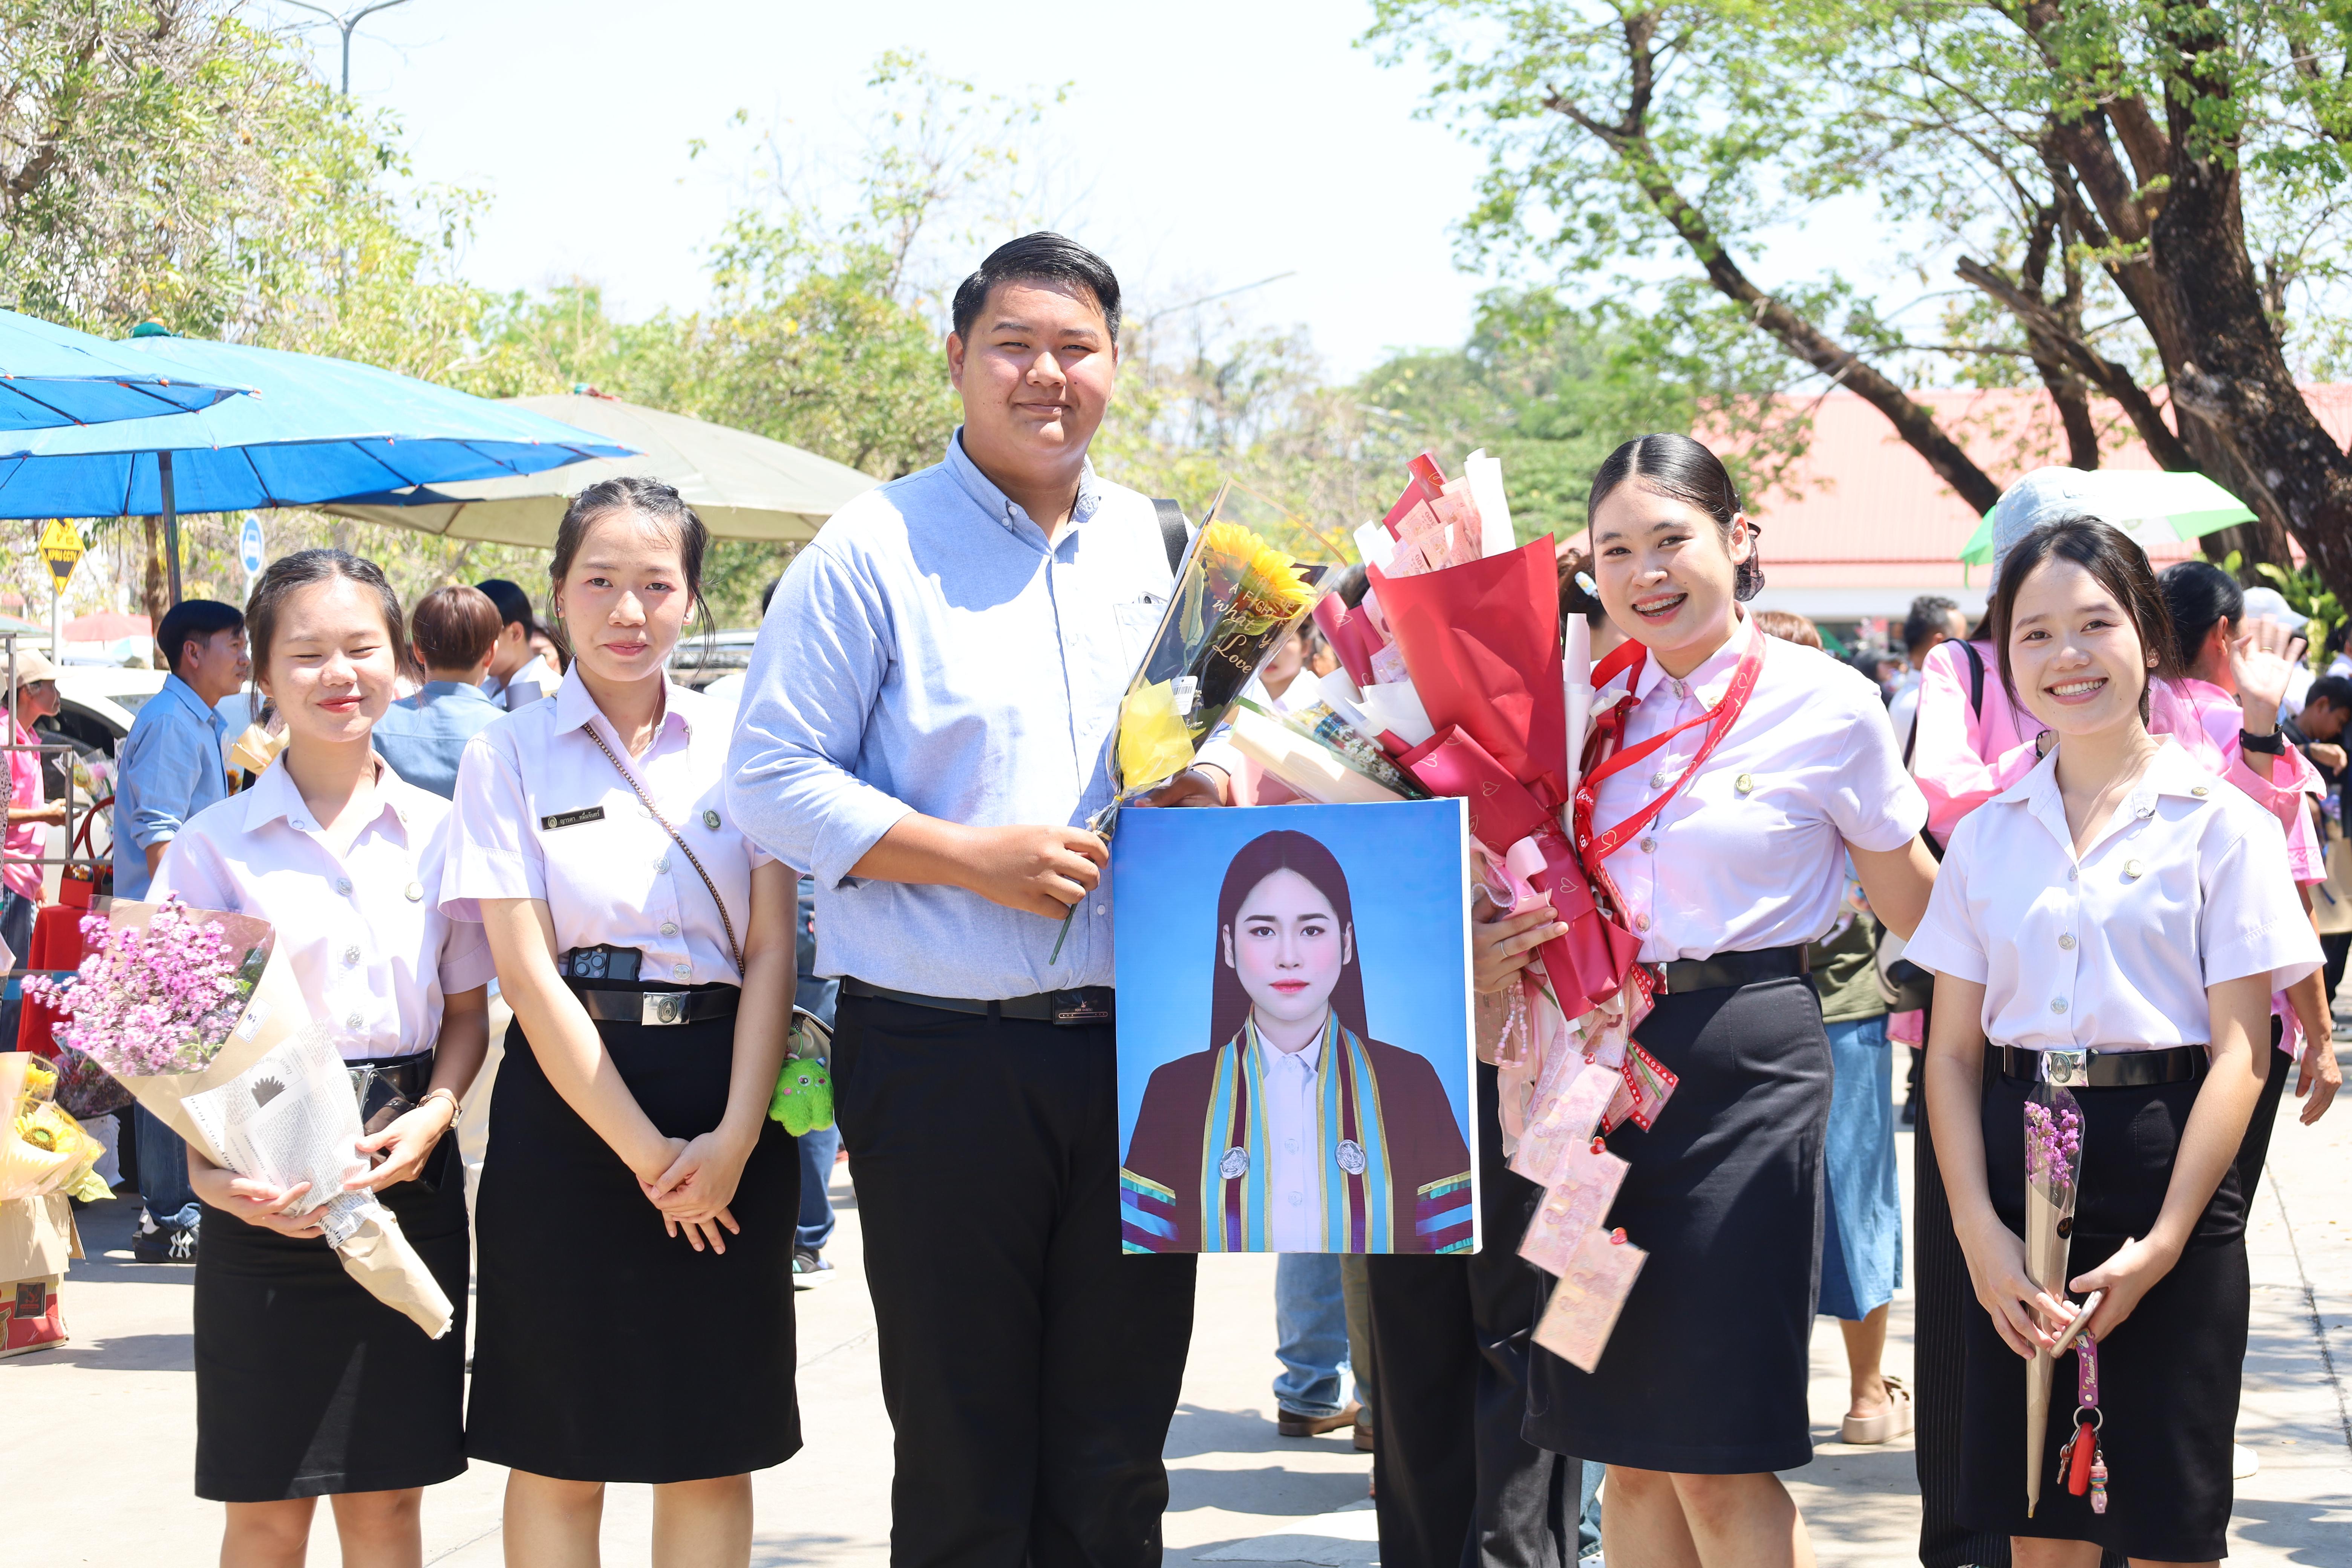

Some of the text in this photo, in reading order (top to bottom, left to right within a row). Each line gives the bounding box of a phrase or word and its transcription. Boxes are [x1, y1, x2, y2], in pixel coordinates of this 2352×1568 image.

[1228, 582, 1239, 595] A
[1212, 599, 1255, 631] what
[1212, 634, 1253, 674] Love
[1576, 788, 1594, 806] love
[2085, 1355, 2095, 1385] Unicorn
